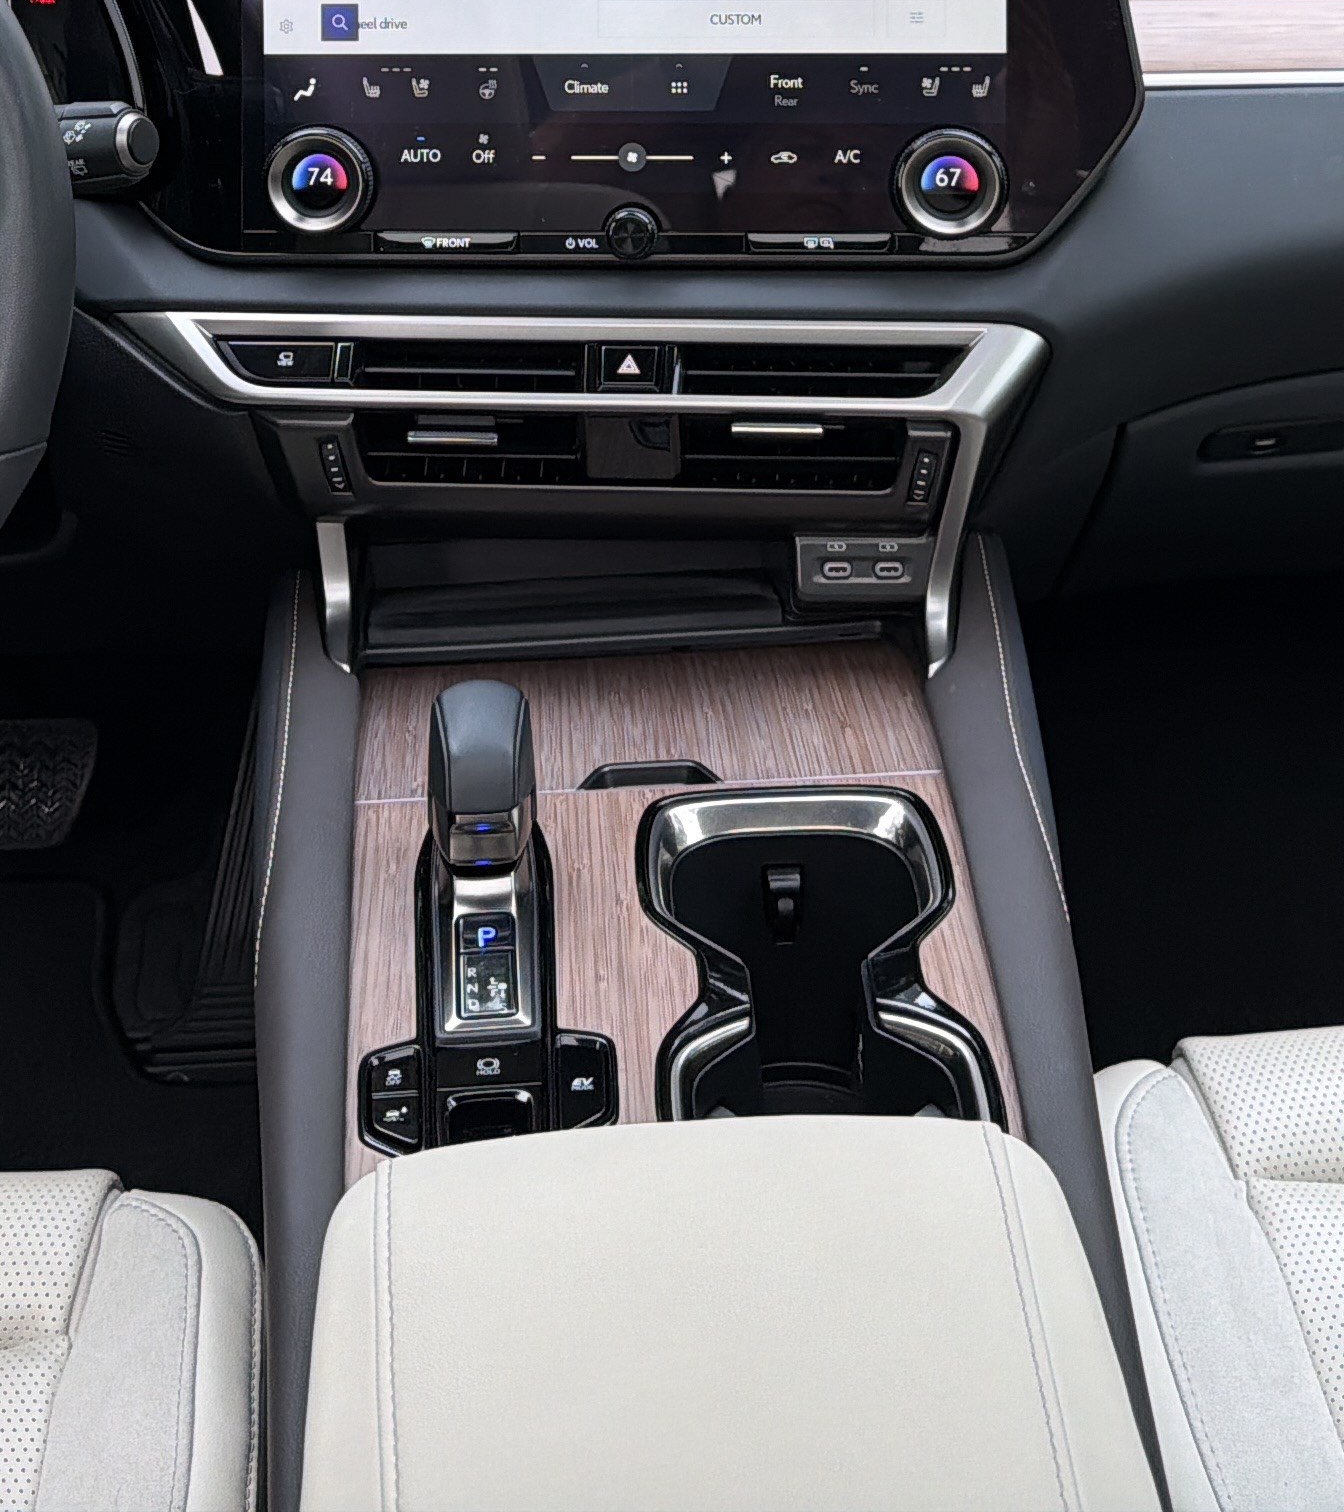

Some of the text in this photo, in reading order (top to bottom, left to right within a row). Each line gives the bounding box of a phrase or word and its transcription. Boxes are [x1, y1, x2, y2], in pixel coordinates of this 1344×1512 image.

[359, 17, 407, 29] eel drive
[710, 13, 762, 26] CUSTOM
[564, 80, 609, 94] Climate
[770, 75, 803, 89] Front
[850, 80, 879, 94] Sync
[774, 95, 798, 107] Rear
[400, 150, 441, 163] AUTO
[472, 149, 496, 163] Off
[834, 150, 861, 164] A/C
[307, 168, 333, 186] 74
[935, 168, 962, 187] 67
[436, 237, 471, 249] FRONT
[578, 237, 599, 249] VOL
[478, 927, 496, 948] P
[467, 967, 477, 978] R
[467, 982, 479, 994] N
[468, 998, 480, 1012] D
[476, 1067, 501, 1076] HOLD
